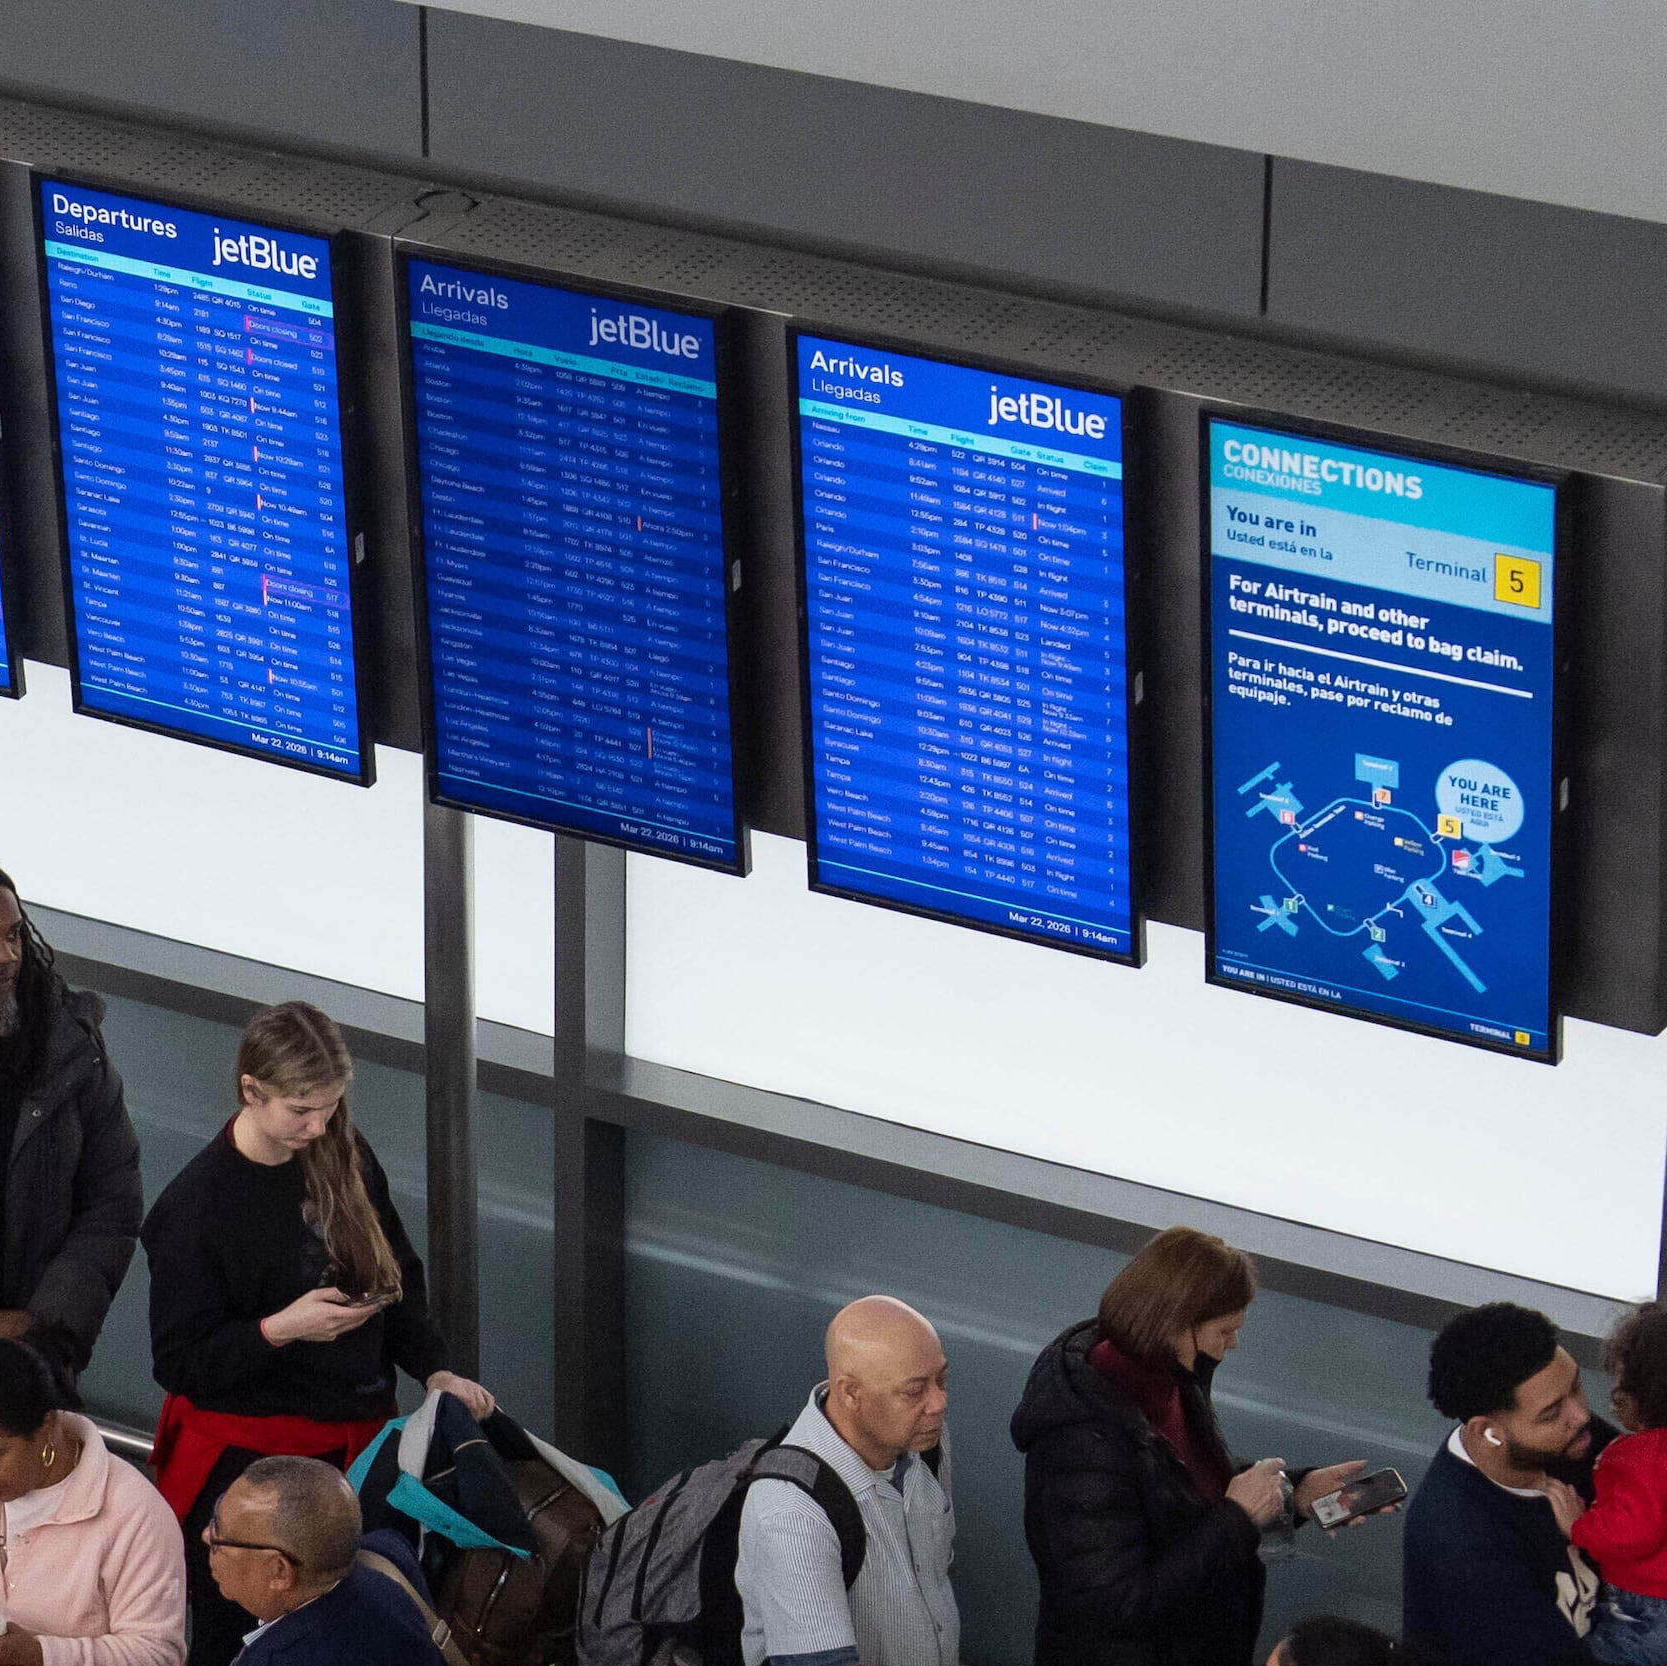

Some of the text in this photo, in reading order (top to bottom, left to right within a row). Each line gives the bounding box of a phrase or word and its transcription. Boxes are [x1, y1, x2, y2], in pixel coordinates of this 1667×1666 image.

[53, 193, 177, 238] Departures
[55, 220, 104, 242] Salidas
[212, 227, 317, 278] jetBlue
[55, 246, 98, 262] Destination
[152, 267, 170, 278] Time
[246, 287, 272, 300] Status
[301, 300, 320, 311] Gate
[420, 274, 508, 309] Arrivals
[422, 301, 487, 325] Llegadas
[589, 307, 699, 358] jetBlue
[810, 350, 903, 386] Arrivals
[812, 378, 880, 403] Llegadas
[987, 385, 1105, 438] jetBlue
[811, 405, 843, 420] Arriving
[844, 411, 865, 422] from
[908, 424, 928, 435] Time
[950, 433, 974, 445] Flight
[1010, 445, 1031, 456] Gate
[1036, 450, 1064, 463] Status
[1223, 464, 1321, 495] CONEXIONES
[1224, 439, 1422, 499] CONNECTIONS
[1226, 504, 1316, 537] You are in
[1226, 528, 1332, 560] Usted está en la
[1405, 551, 1523, 593] Terminal 5
[1229, 574, 1429, 629] For Airtrain and other
[1040, 637, 1070, 650] Landed
[1229, 594, 1523, 671] terminals, proceed to bag claim.
[1228, 651, 1439, 708] Para ir hacia el Airtrain y otras
[1228, 683, 1290, 705] equipaje.
[1228, 666, 1452, 725] terminales, pase por reclamo de
[251, 732, 348, 764] Mar 22, 2026 9:14am
[825, 753, 850, 765] Tampa
[1448, 775, 1510, 799] YOU ARE
[1460, 792, 1499, 811] HERE
[1445, 819, 1454, 833] 5
[1454, 806, 1486, 819] USTED
[620, 822, 723, 854] Mar 22, 2026 9:14am
[1423, 893, 1432, 905] 4
[1009, 911, 1117, 944] Mar 22, 2026 9:14am
[1222, 964, 1265, 981] YOU ARE IN
[1270, 975, 1341, 999] USTED ESTÁ EN LA
[1469, 1022, 1511, 1039] TERMINAL
